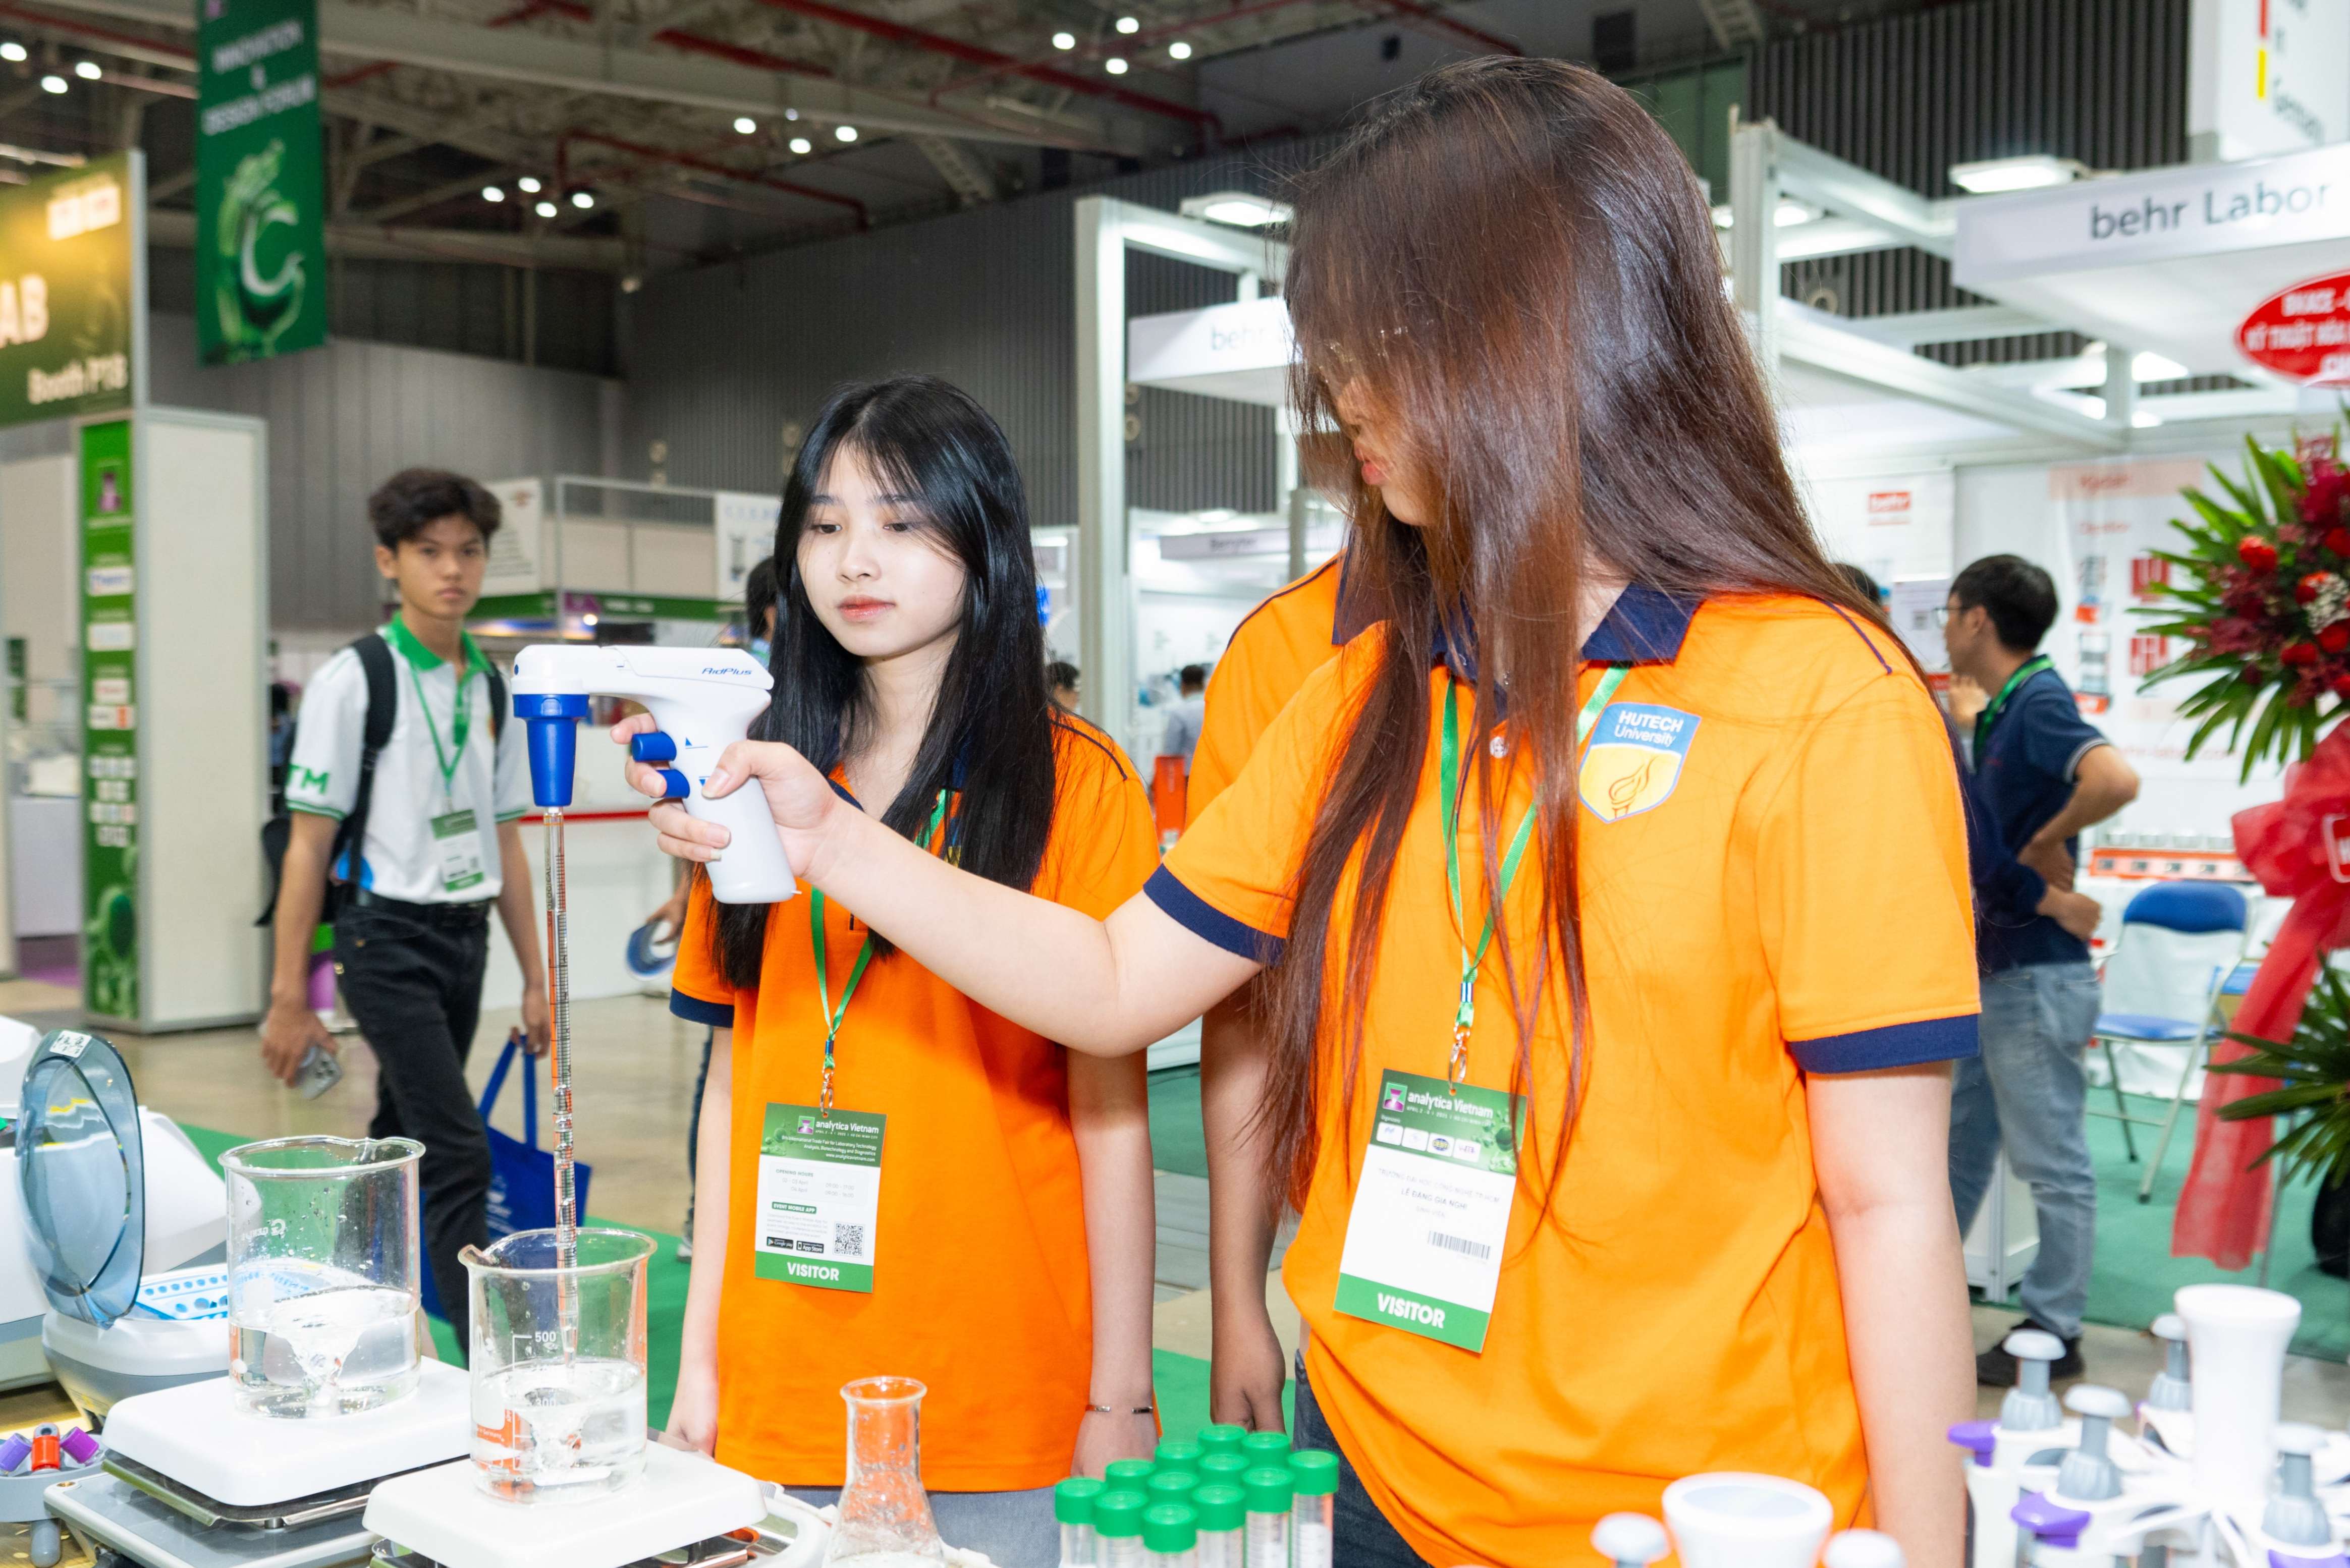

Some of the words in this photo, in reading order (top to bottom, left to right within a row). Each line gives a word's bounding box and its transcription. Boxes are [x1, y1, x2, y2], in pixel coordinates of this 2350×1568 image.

[2090, 197, 2188, 241] behr
[2204, 181, 2330, 226] Labor
[701, 666, 753, 677] AidPlus
[1619, 710, 1684, 733] HUTECH
[1614, 725, 1676, 748] University
[1407, 1092, 1452, 1110] analytica
[1454, 1098, 1494, 1118] Vietnam
[816, 1121, 849, 1131] analytica
[850, 1123, 879, 1134] Vietnam
[821, 1146, 846, 1154] Biotechnology
[826, 1154, 876, 1162] www.analyticavietnam.com
[787, 1262, 840, 1281] VISITOR
[1377, 1293, 1446, 1329] VISITOR
[535, 1332, 557, 1343] 500
